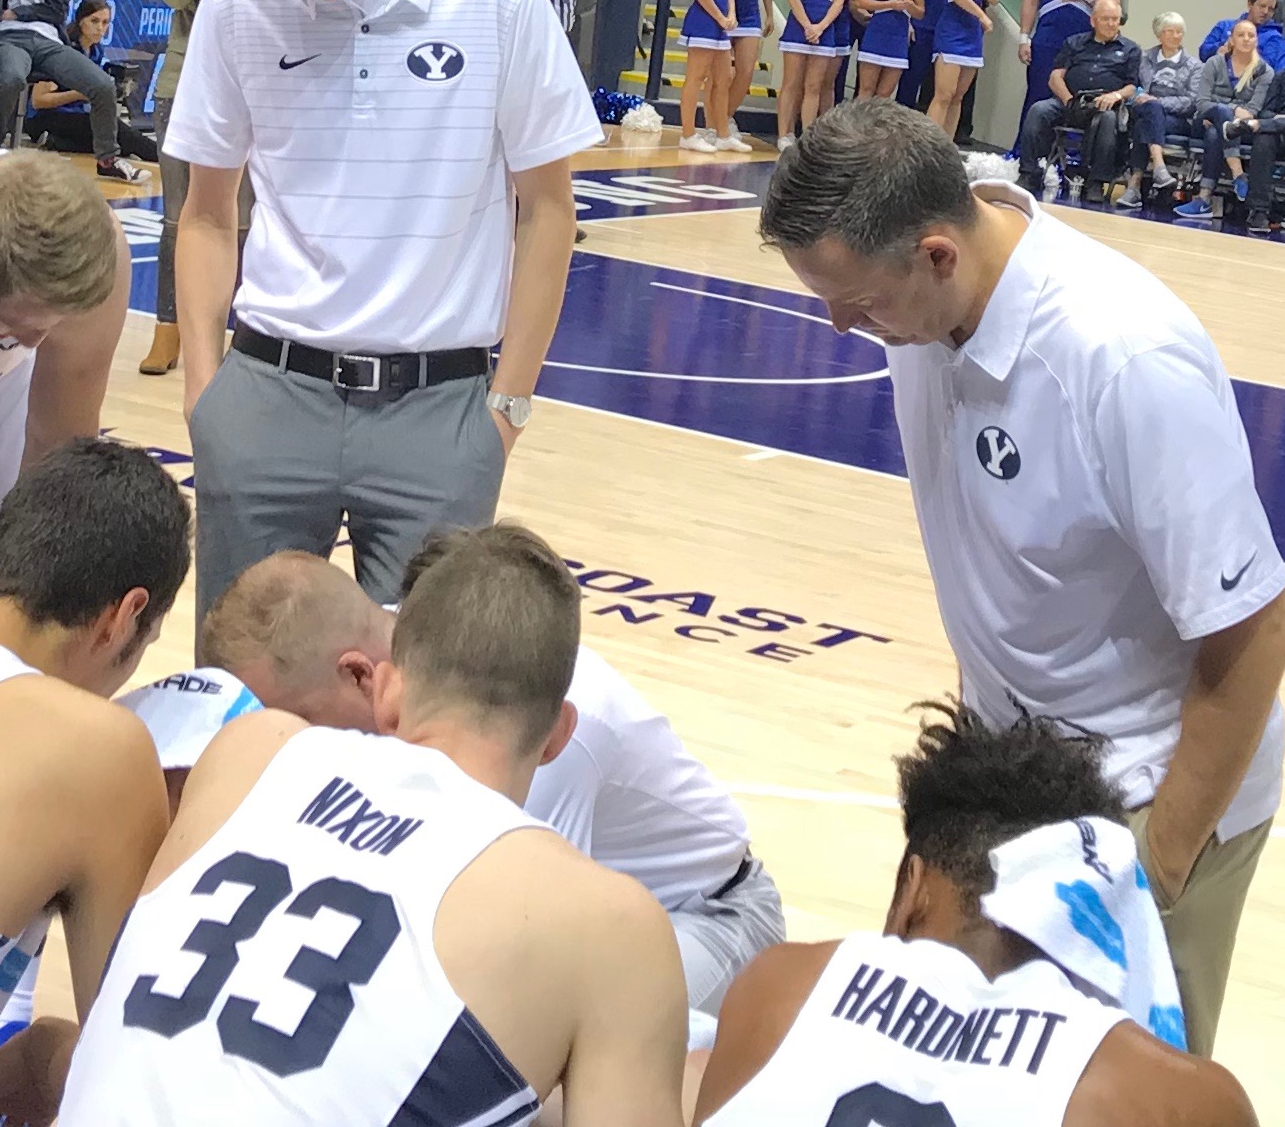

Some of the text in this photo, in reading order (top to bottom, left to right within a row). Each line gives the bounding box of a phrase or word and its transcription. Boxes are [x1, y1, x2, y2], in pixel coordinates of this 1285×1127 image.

[562, 558, 894, 648] OAST
[295, 775, 425, 856] NIXON
[122, 850, 403, 1079] 33
[830, 962, 1068, 1076] HARDNETT
